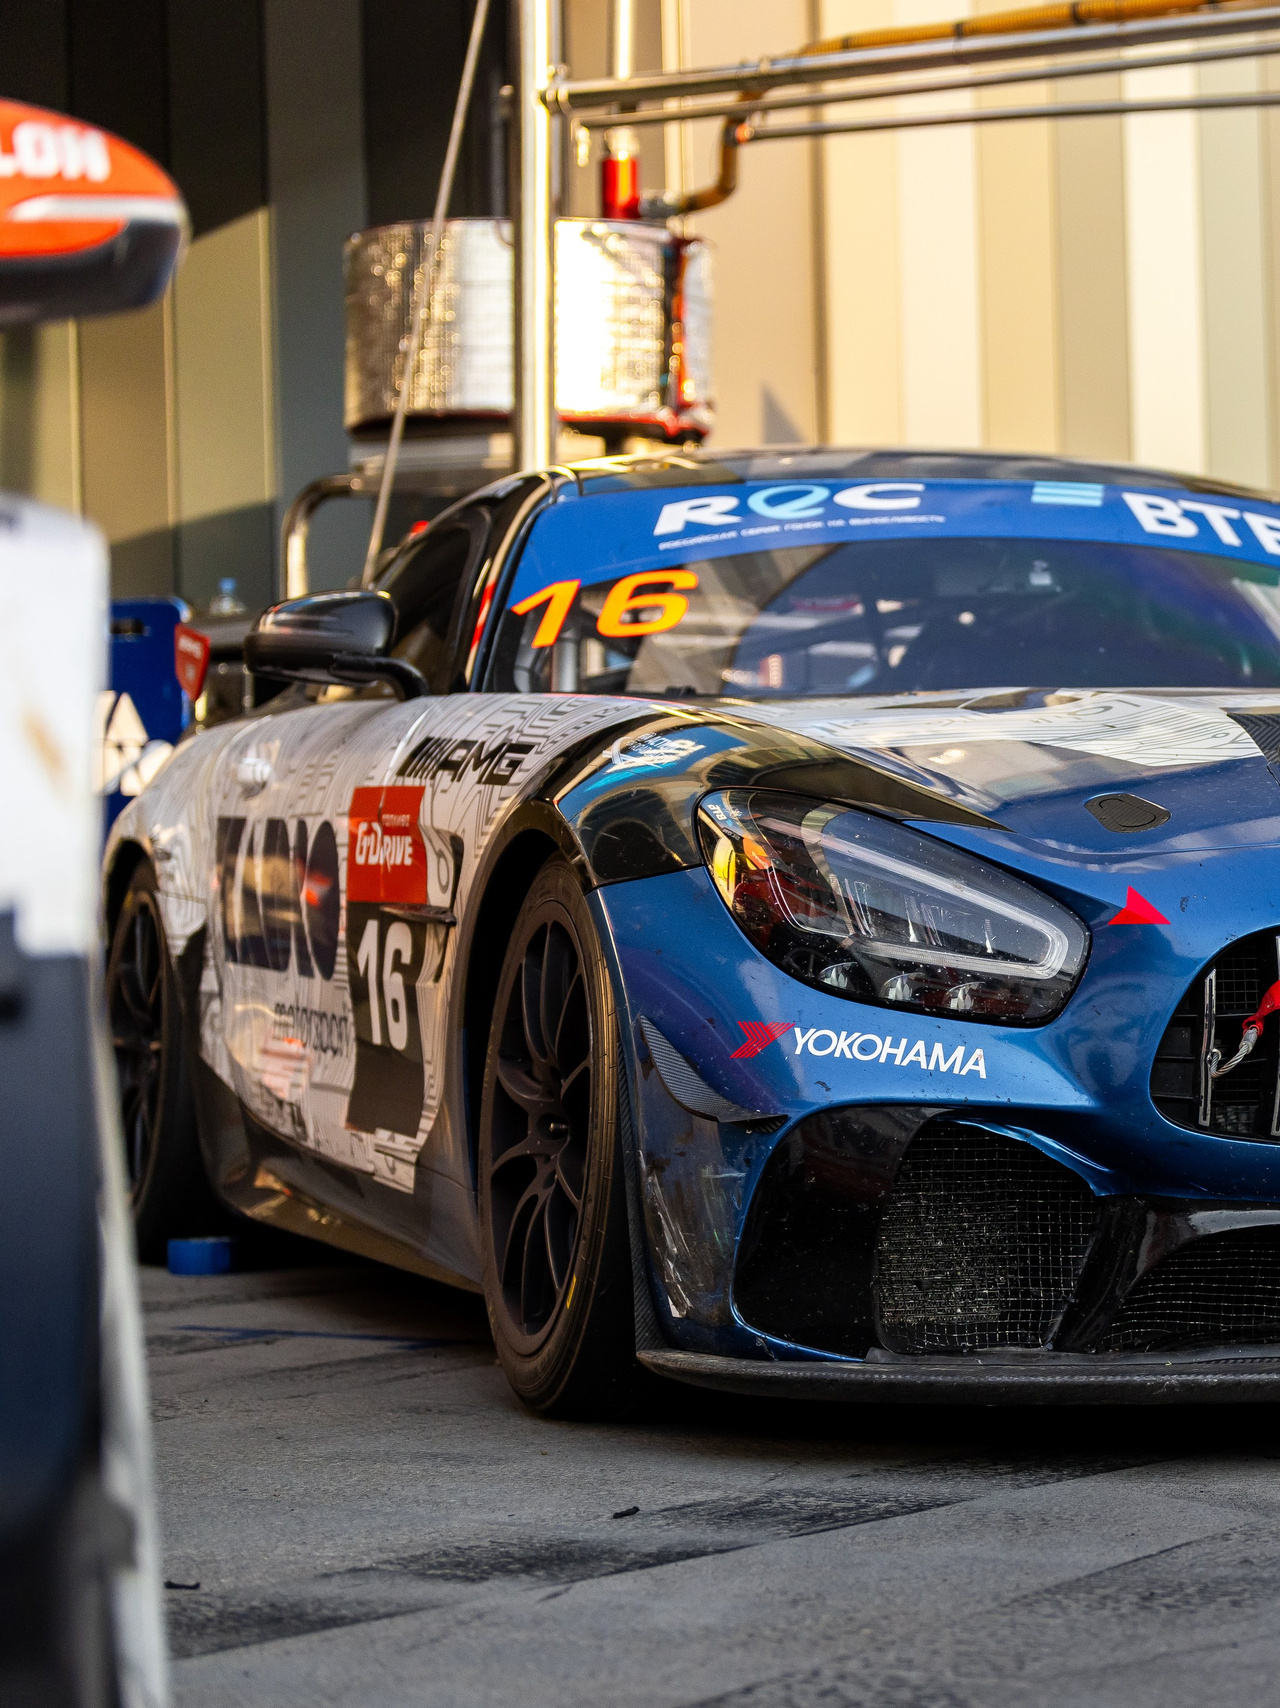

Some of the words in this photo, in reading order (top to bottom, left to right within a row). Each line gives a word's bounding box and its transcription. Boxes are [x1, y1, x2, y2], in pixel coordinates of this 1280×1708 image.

[511, 569, 699, 649] 16
[357, 918, 412, 1050] 16
[794, 1027, 987, 1079] YOKOHAMA
